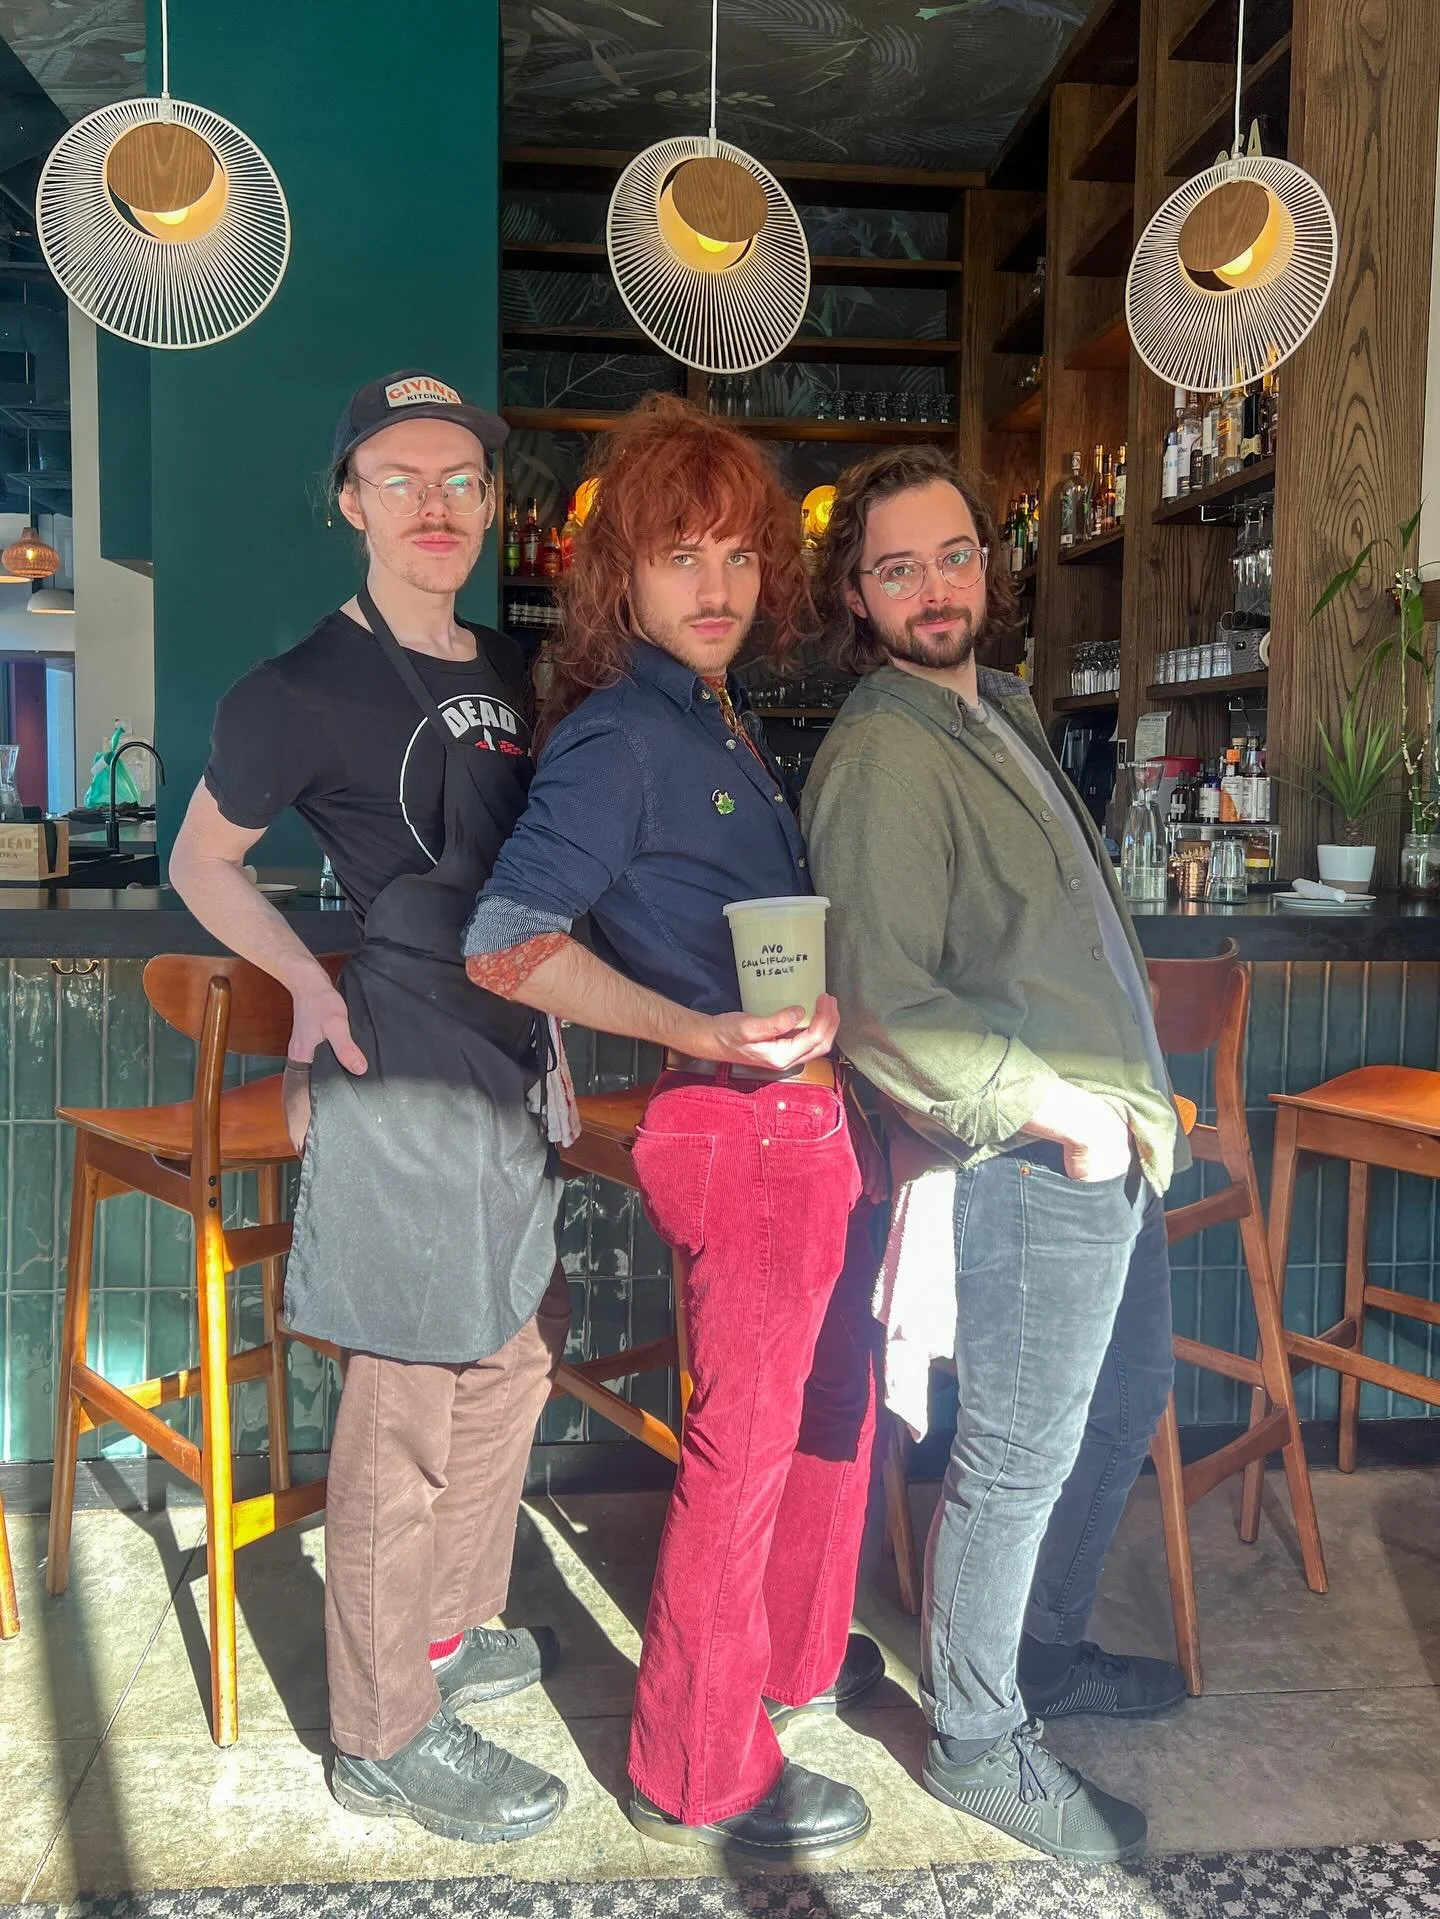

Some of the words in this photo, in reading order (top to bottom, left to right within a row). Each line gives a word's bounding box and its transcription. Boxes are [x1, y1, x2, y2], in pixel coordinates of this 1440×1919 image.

[388, 379, 460, 404] GIVING
[407, 393, 448, 402] KITCHEN
[441, 700, 517, 738] DEAD
[762, 944, 783, 954] AVO
[741, 954, 808, 968] CAULIFLOWER
[756, 966, 795, 977] BISQUE
